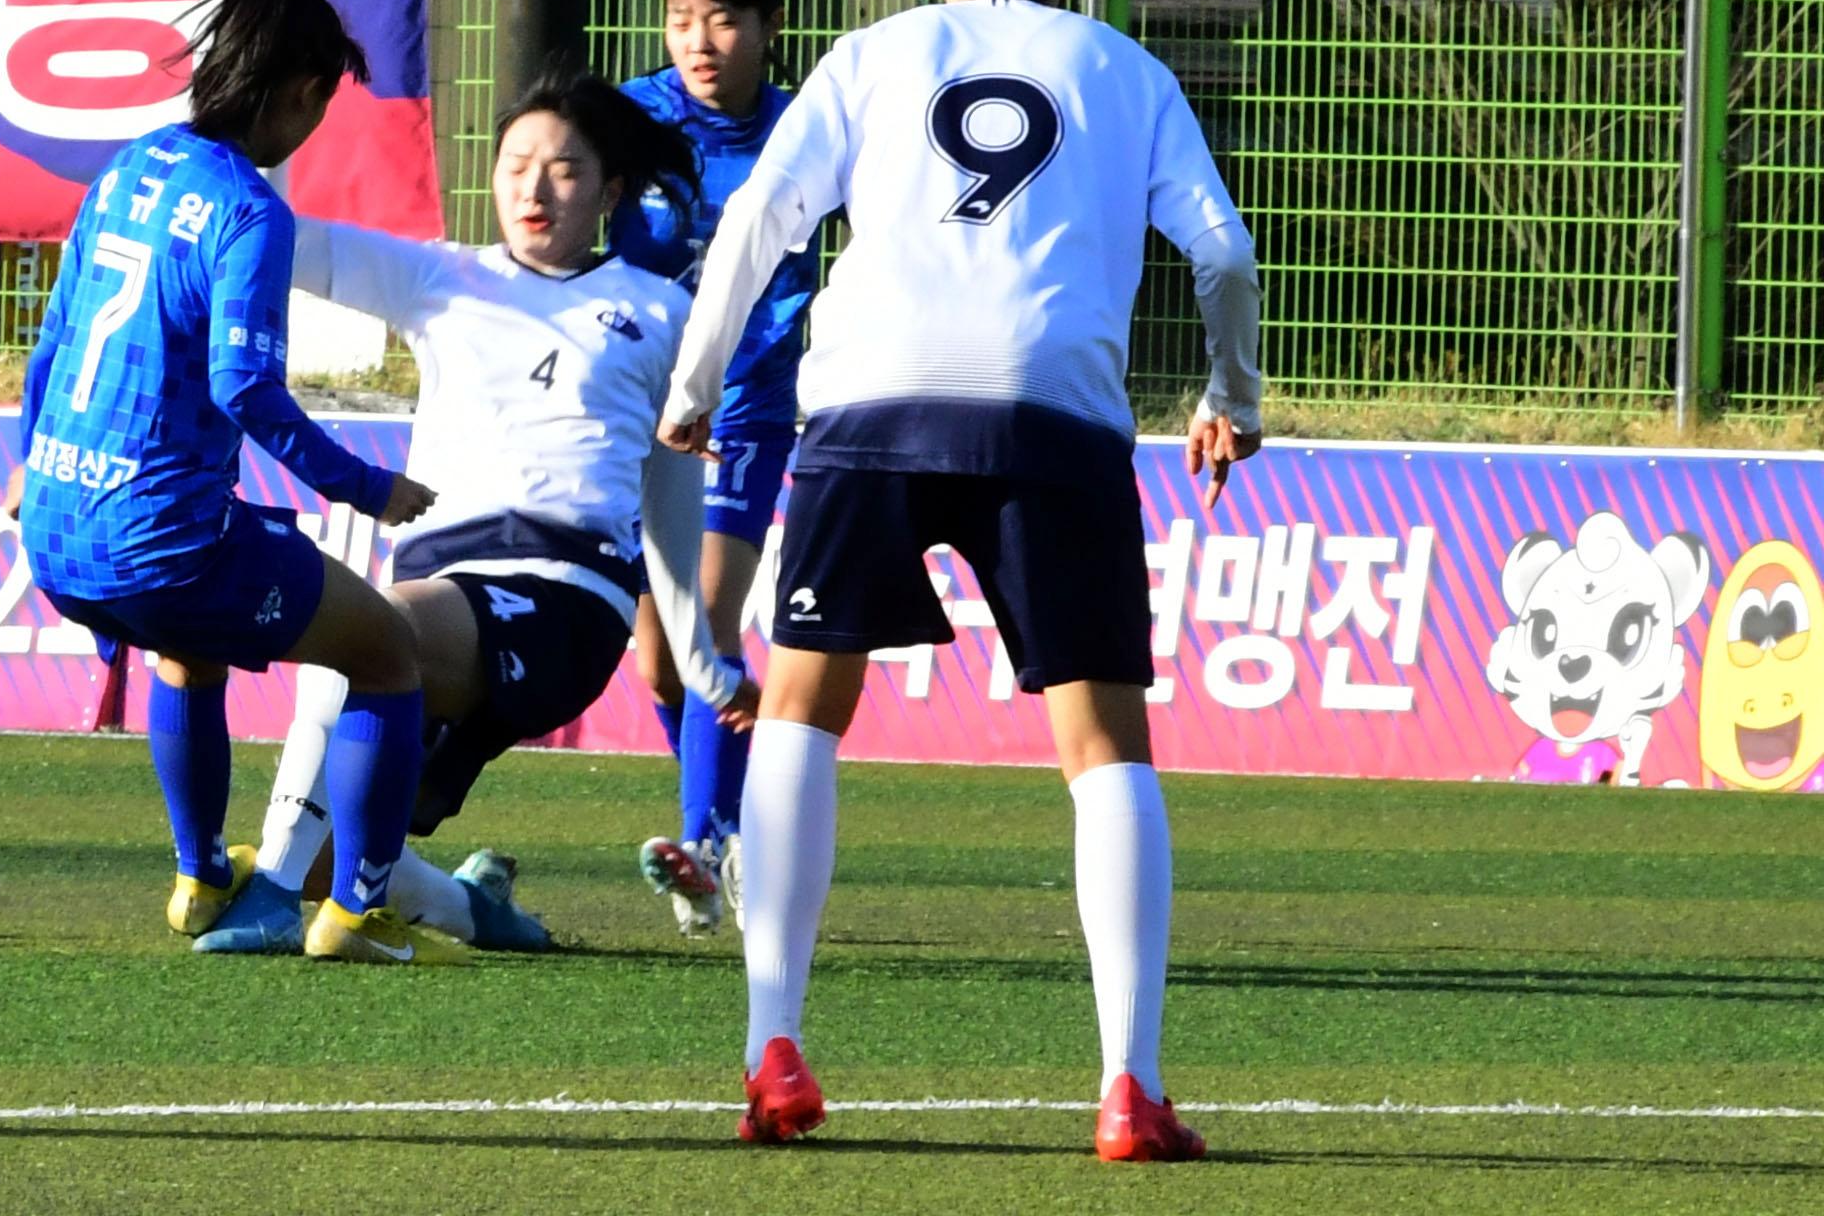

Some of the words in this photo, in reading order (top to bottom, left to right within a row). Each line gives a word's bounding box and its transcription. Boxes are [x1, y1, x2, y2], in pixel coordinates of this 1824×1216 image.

[926, 73, 1065, 225] 9
[71, 232, 153, 412] 7
[529, 349, 560, 391] 4
[704, 439, 758, 492] 17
[481, 584, 536, 622] 4
